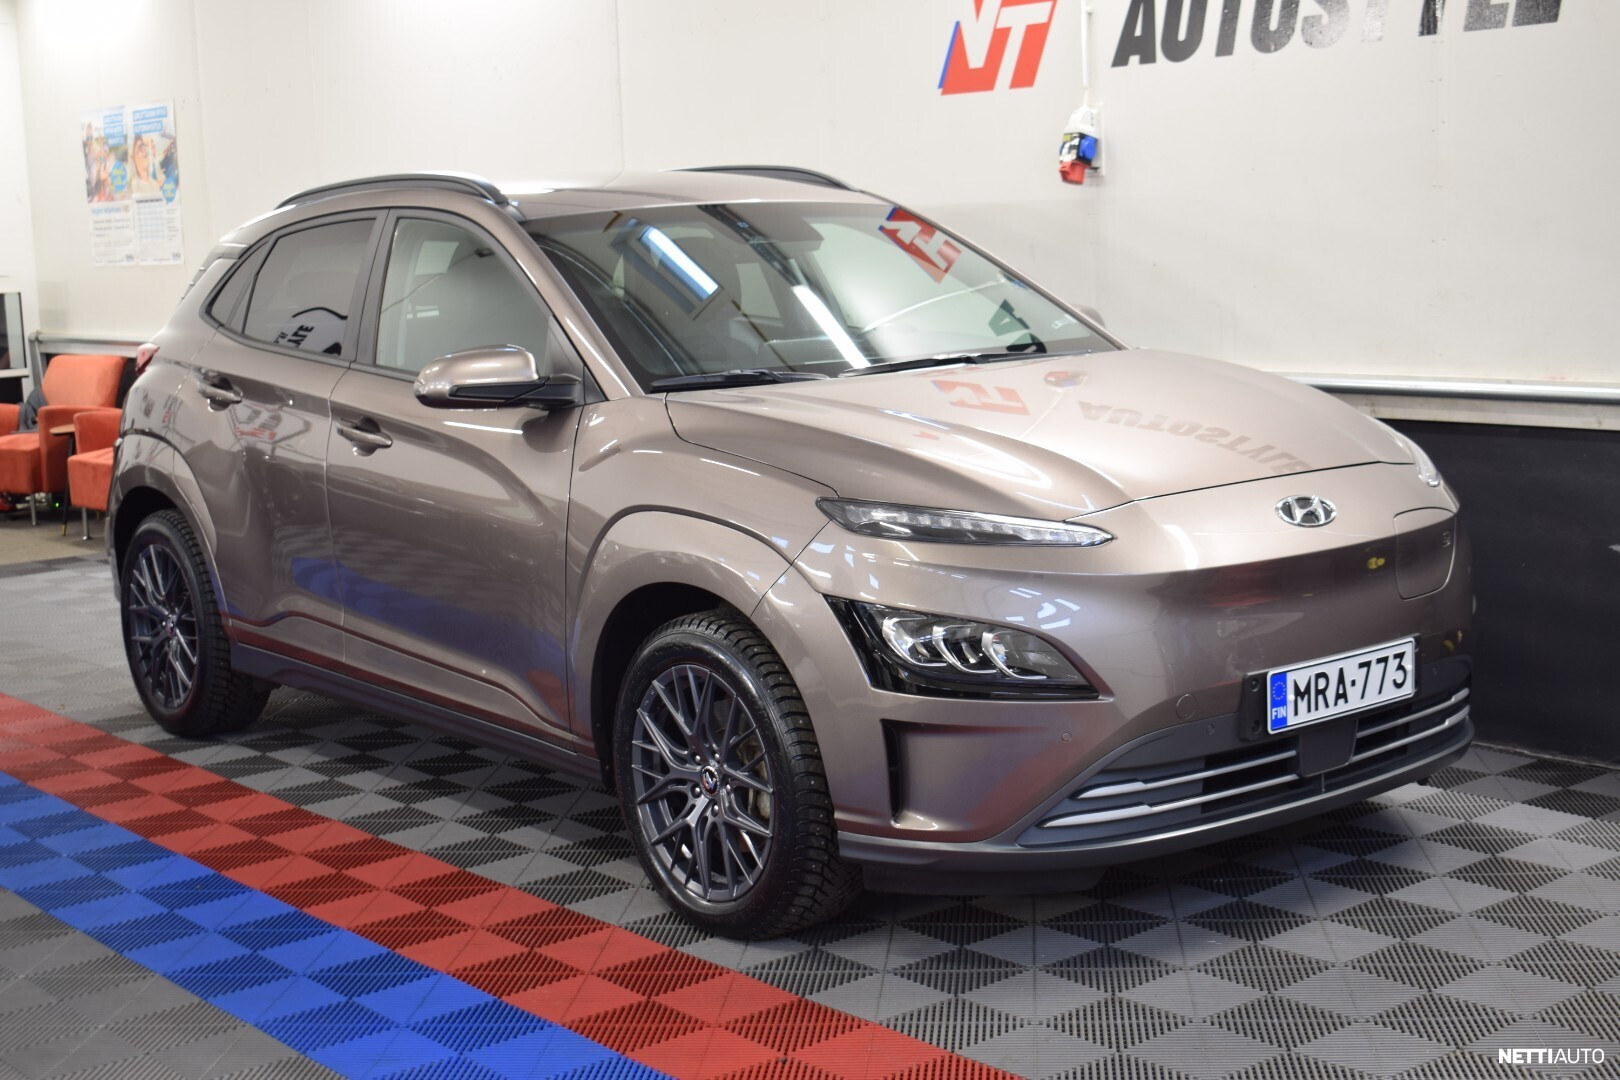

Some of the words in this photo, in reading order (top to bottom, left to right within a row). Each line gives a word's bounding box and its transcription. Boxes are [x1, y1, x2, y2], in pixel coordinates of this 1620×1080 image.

[1111, 0, 1562, 68] AUTOS
[1272, 705, 1287, 720] FIN
[1293, 651, 1407, 717] MRA-773
